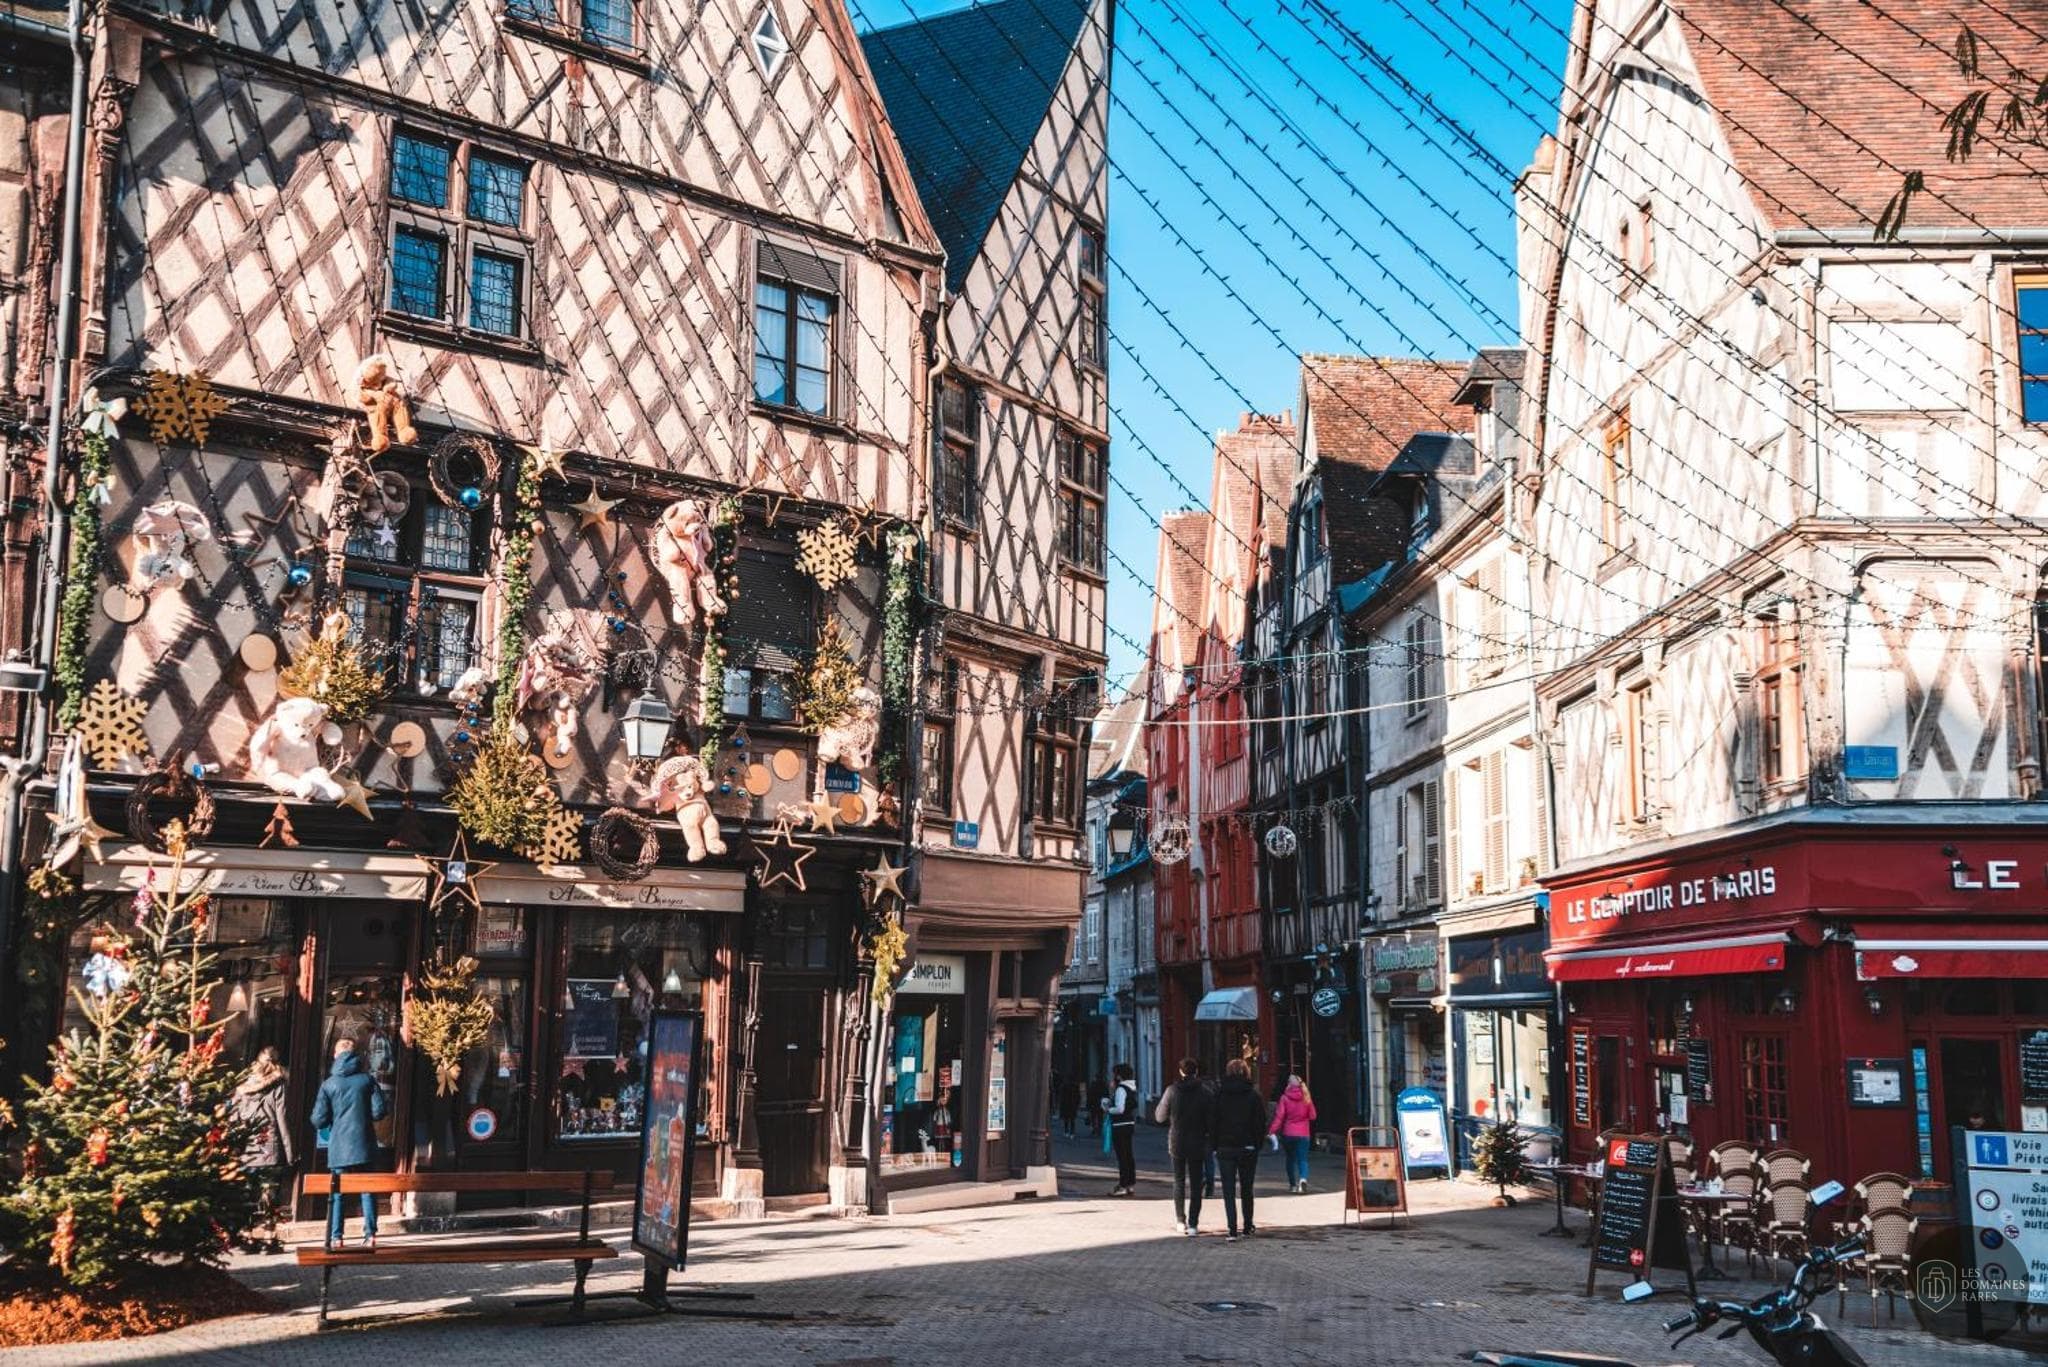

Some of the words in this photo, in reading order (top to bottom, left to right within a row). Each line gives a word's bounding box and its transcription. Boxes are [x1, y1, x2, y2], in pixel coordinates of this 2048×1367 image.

[1952, 861, 2020, 888] LE
[1568, 899, 1587, 923] LE
[1590, 885, 1674, 919] COMPTOIR
[1680, 878, 1706, 906] DE
[2013, 1139, 2042, 1151] Voie
[2021, 1206, 2048, 1218] véhi
[2031, 1259, 2048, 1271] Ho
